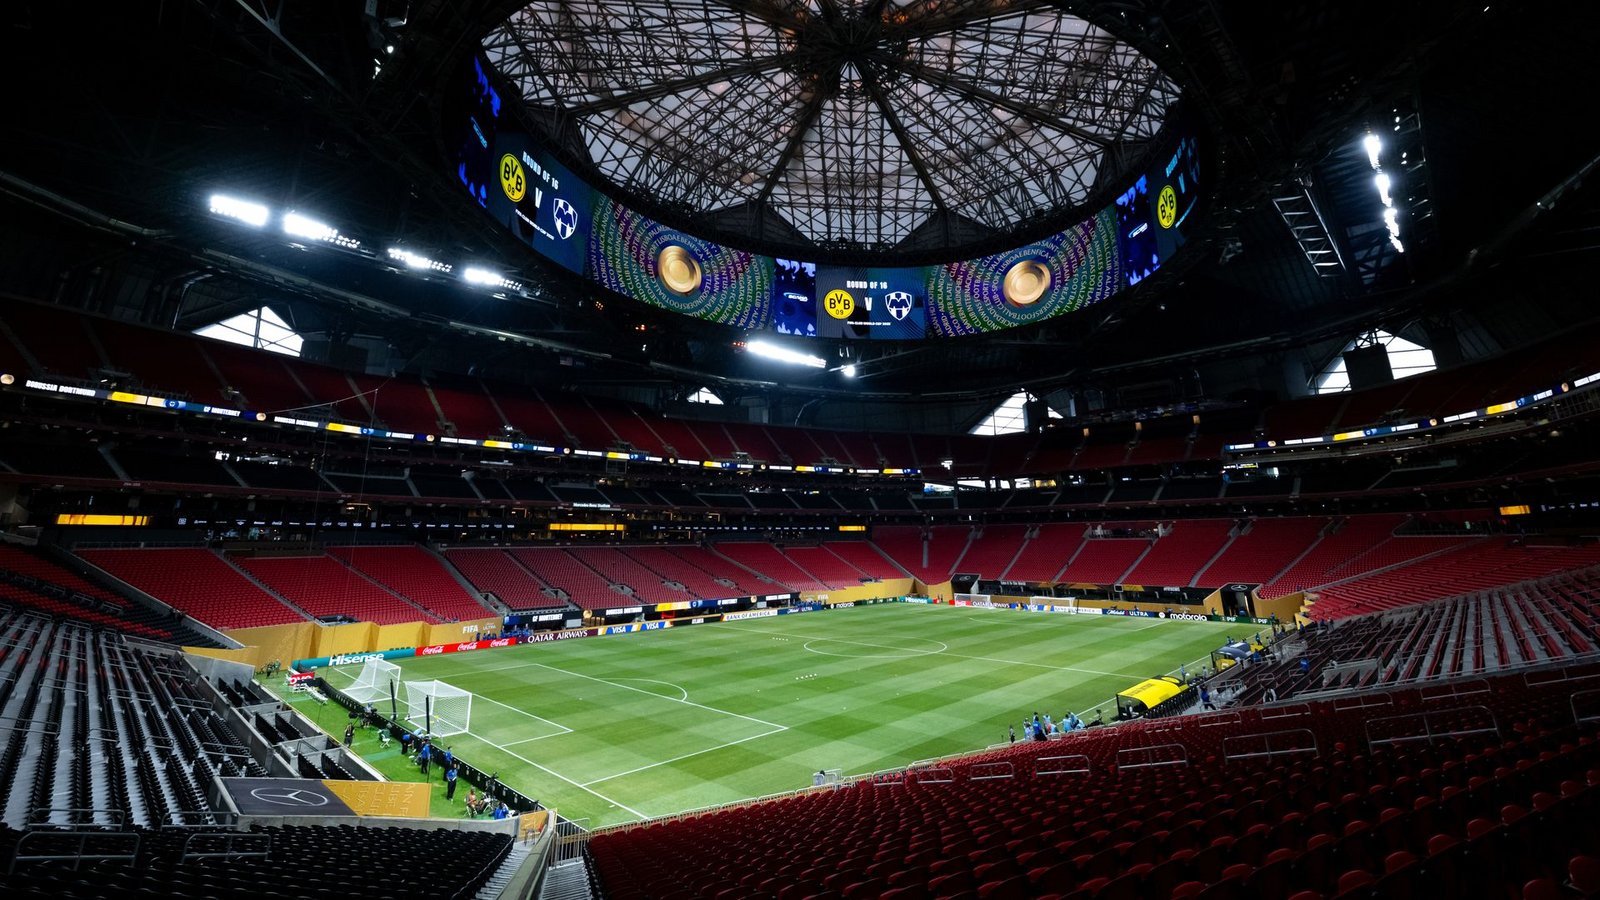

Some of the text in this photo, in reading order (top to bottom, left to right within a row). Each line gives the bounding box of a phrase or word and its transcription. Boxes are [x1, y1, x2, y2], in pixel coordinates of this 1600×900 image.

[504, 159, 522, 192] BVB
[522, 150, 559, 190] ROUND OF 16
[534, 187, 542, 208] V
[1160, 191, 1174, 220] BVB
[631, 227, 646, 263] FOOTBALL
[657, 233, 677, 247] LISBOA
[681, 237, 702, 260] BENFICA
[648, 242, 658, 261] SPORT
[1024, 248, 1049, 259] BENFICA
[1000, 254, 1019, 272] LISBOA
[1050, 256, 1062, 284] SEATTLE
[648, 265, 656, 282] CLUB
[703, 261, 712, 289] SEATTLE
[992, 270, 1002, 292] SPORT
[1060, 240, 1079, 312] JUVENTUS FOOTBALL
[707, 253, 728, 320] JUVENTUS FOOTBALL
[846, 280, 868, 289] ROUND
[974, 267, 985, 303] FOOTBALL
[653, 281, 684, 310] FOOTBALL
[684, 289, 710, 310] SOUNDERS
[706, 295, 716, 309] REAL
[830, 293, 850, 310] BVB
[865, 297, 872, 311] V
[993, 294, 1003, 310] CLUB
[1036, 283, 1061, 316] SOUNDERS
[1060, 286, 1069, 305] REAL
[26, 380, 96, 396] BORUSSIA DORTMUND
[1170, 612, 1208, 622] motorola
[463, 625, 478, 634] FIFA
[528, 630, 588, 643] QATAR AIRWAYS
[423, 646, 444, 654] Coca-Cola
[458, 642, 478, 651] Coca-Cola
[329, 653, 384, 666] Hisense
